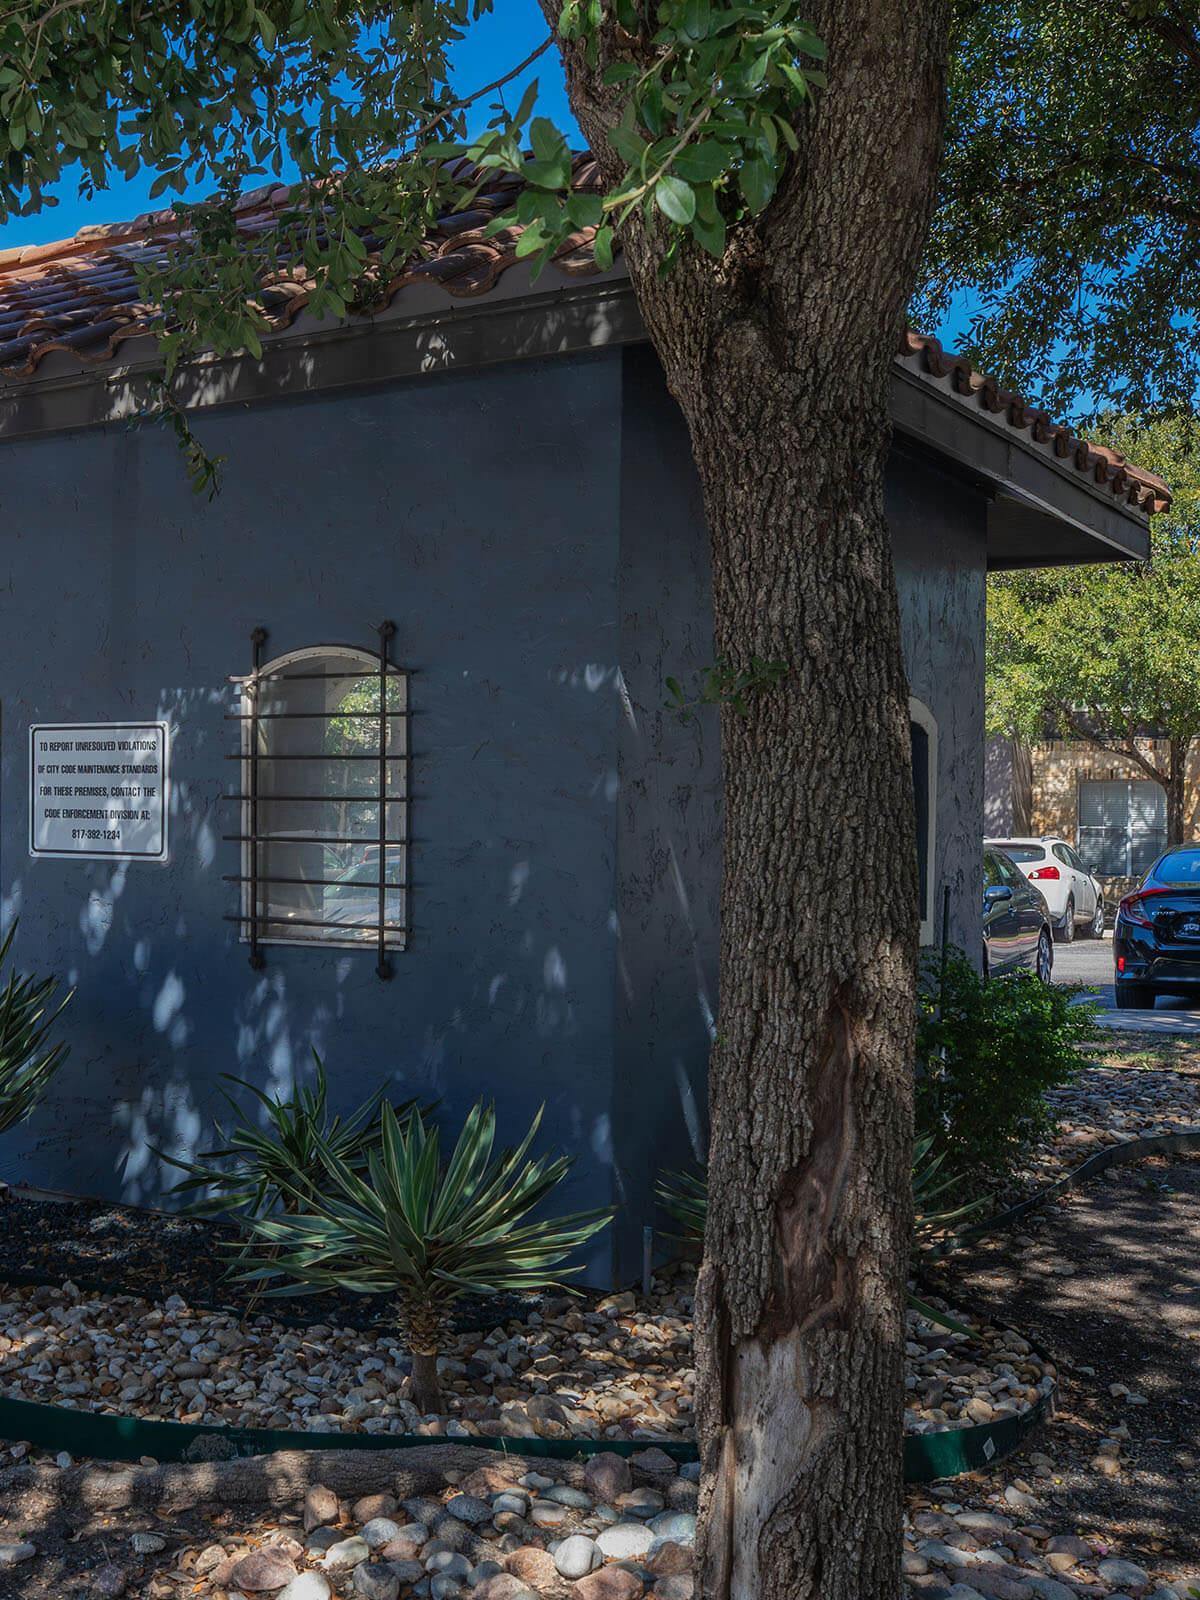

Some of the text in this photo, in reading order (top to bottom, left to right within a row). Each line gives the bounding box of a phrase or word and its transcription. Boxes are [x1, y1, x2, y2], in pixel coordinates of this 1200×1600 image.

[40, 741, 156, 752] TO REPORT UNRESOLVED VIOLATIONS
[38, 765, 158, 774] OF CITY CODE MAINTENANCE STANDARDS
[40, 786, 156, 798] FOR THESE PREMISES, CONTACT THE
[44, 808, 60, 818] CODE
[62, 809, 108, 819] ENFORCEMENT
[110, 810, 138, 820] DIVISION
